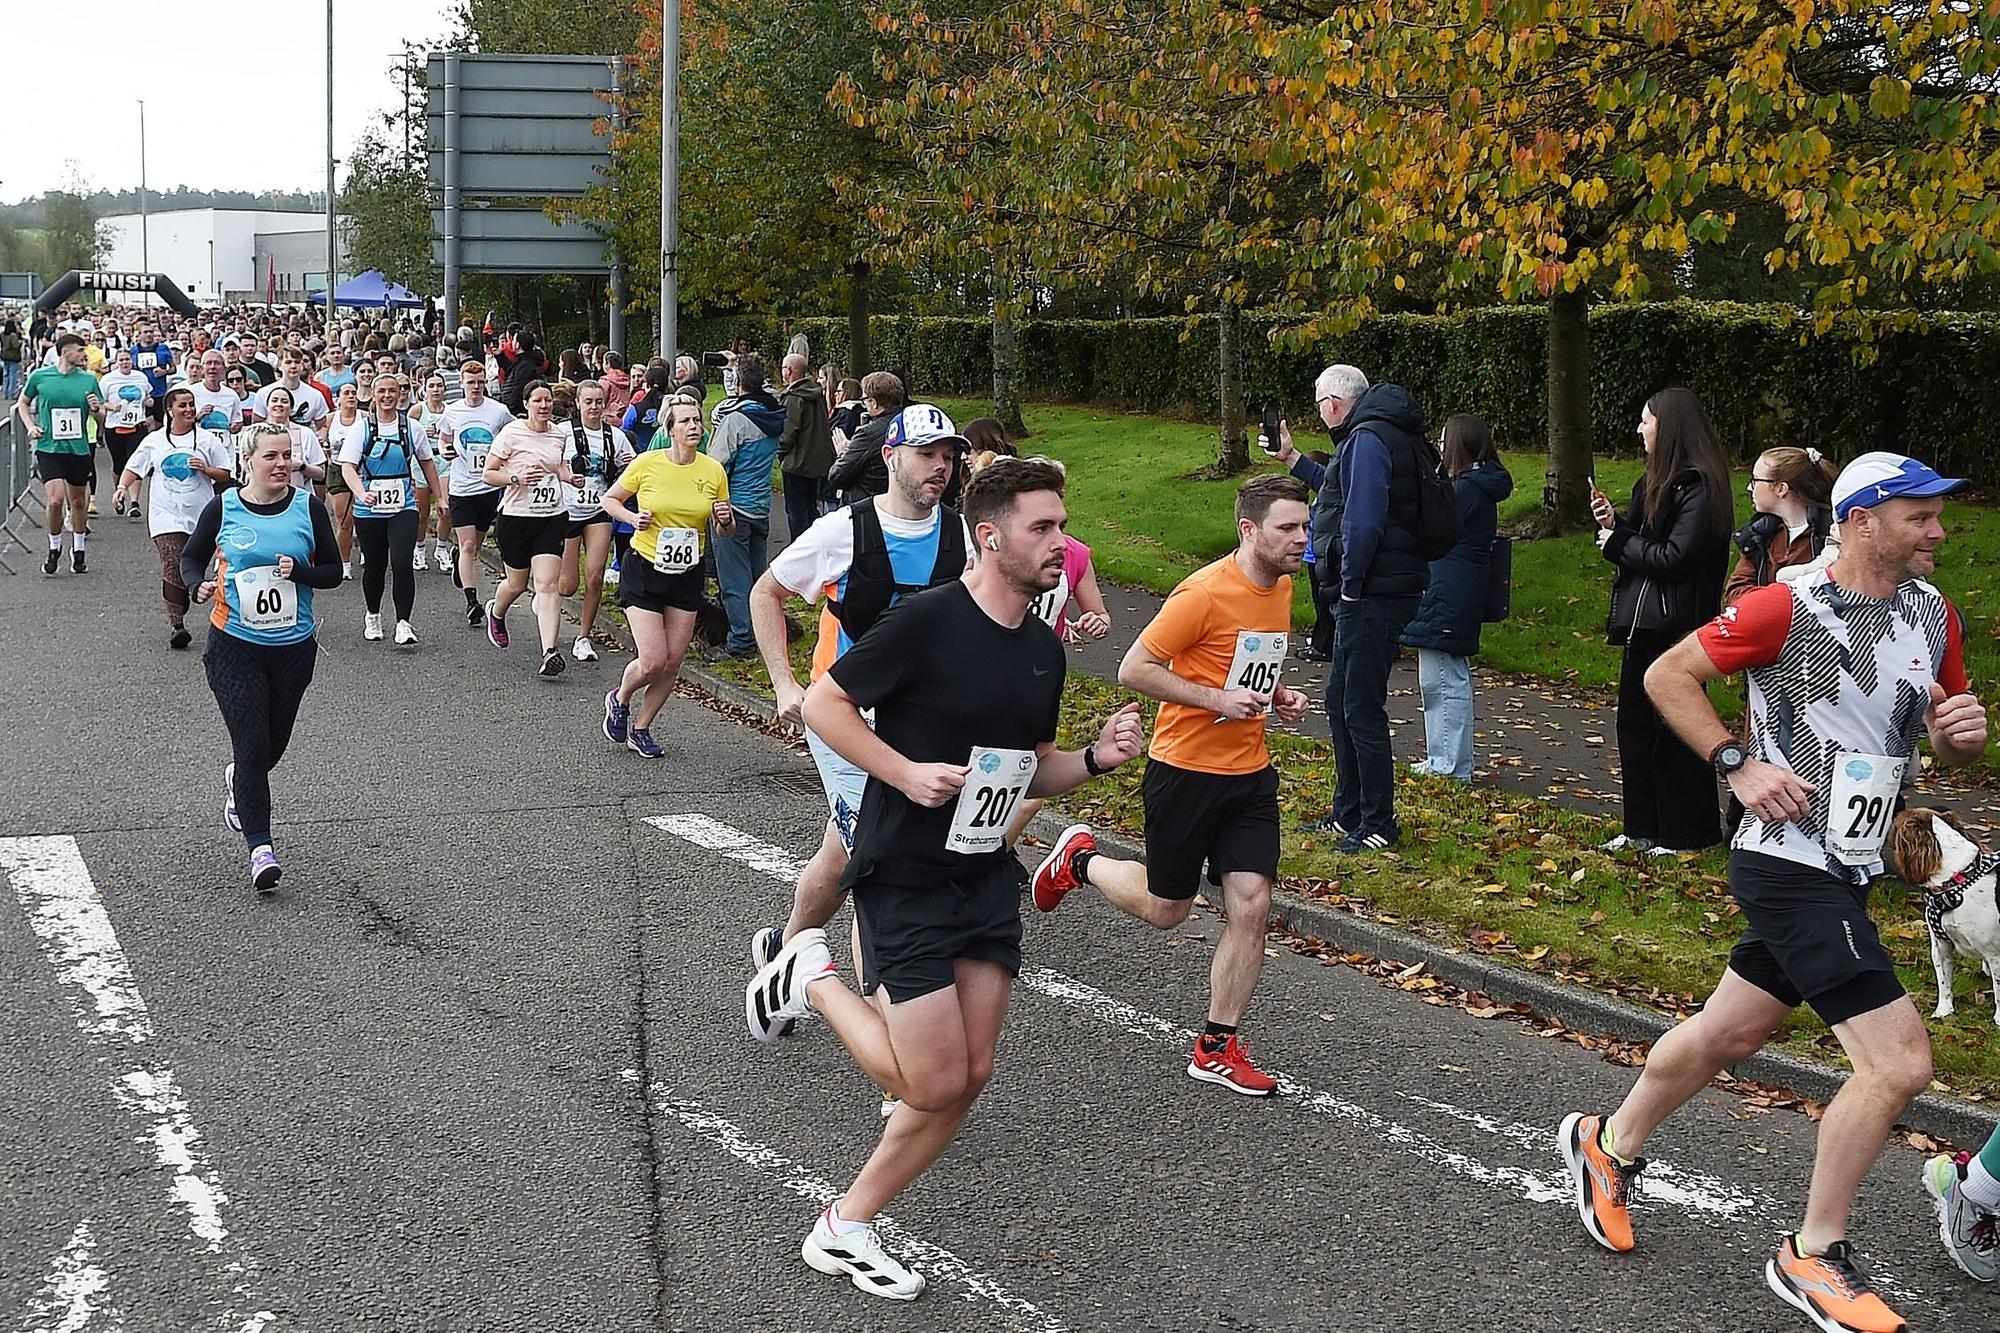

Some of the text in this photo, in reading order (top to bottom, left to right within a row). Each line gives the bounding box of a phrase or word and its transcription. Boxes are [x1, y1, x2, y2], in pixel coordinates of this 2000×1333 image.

[79, 272, 156, 290] FINISH
[60, 419, 73, 432] 31
[378, 489, 400, 505] 132
[532, 487, 556, 504] 292
[577, 489, 601, 504] 316
[662, 544, 693, 565] 368
[256, 588, 282, 615] 60
[1237, 661, 1279, 695] 405
[968, 786, 1023, 828] 207
[1843, 794, 1893, 839] 291
